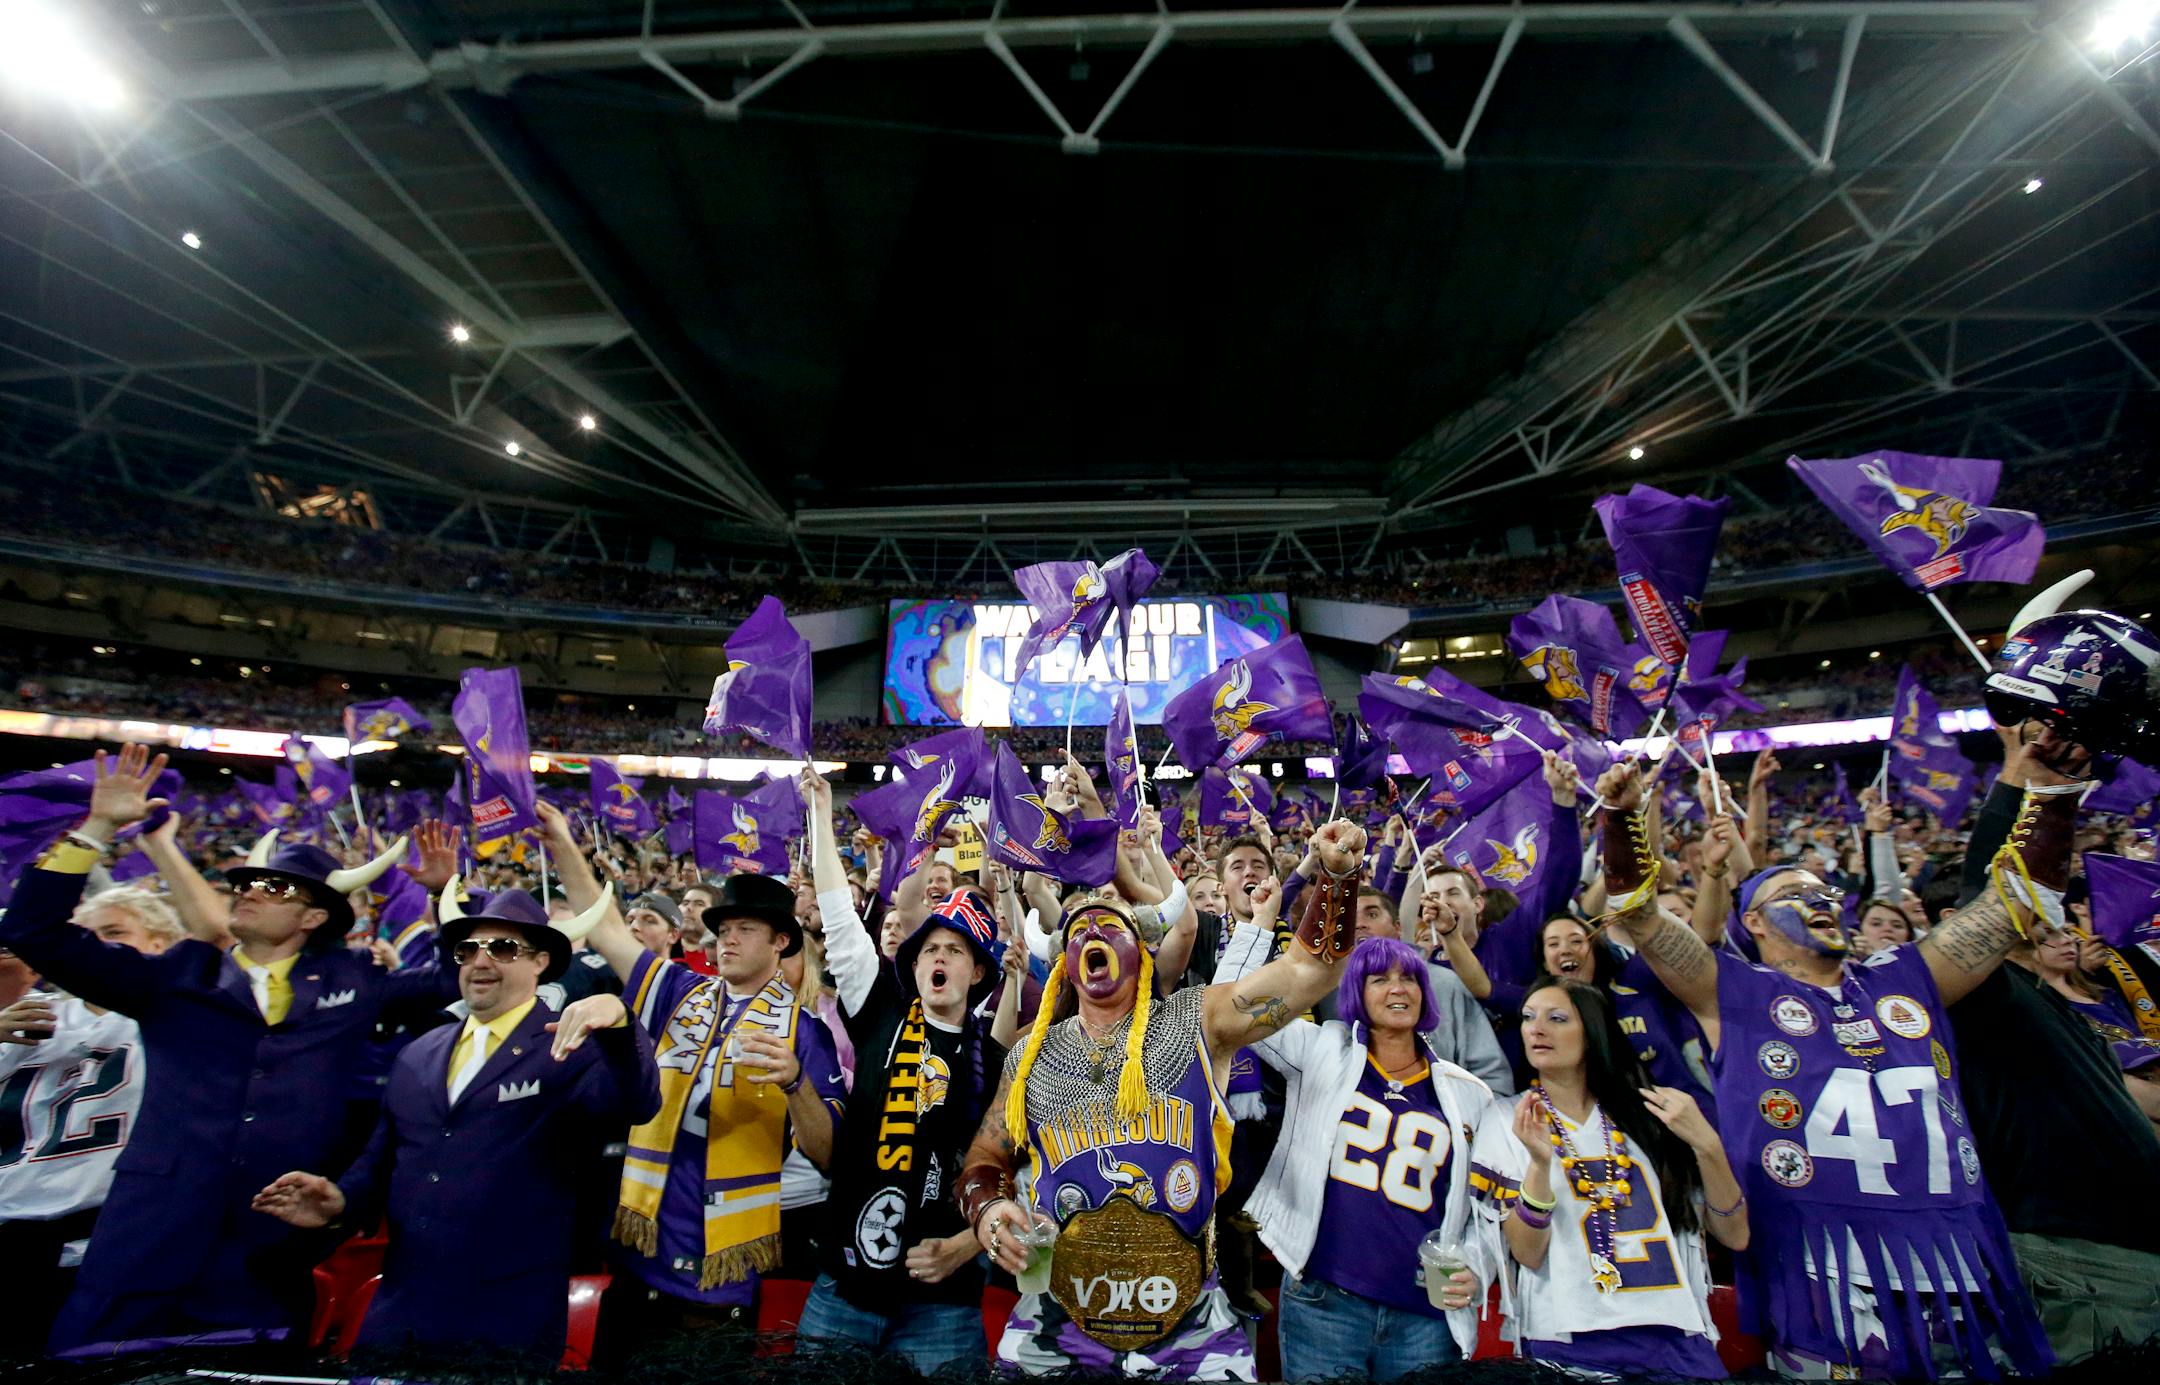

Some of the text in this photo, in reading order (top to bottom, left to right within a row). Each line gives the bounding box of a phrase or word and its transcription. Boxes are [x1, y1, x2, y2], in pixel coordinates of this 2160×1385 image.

[1003, 635, 1171, 682] FLAG!
[959, 850, 982, 860] Blac
[1329, 1090, 1451, 1213] 28
[1804, 1066, 1952, 1196] 47
[1563, 1155, 1684, 1293] 2
[1070, 1270, 1178, 1319] VWO
